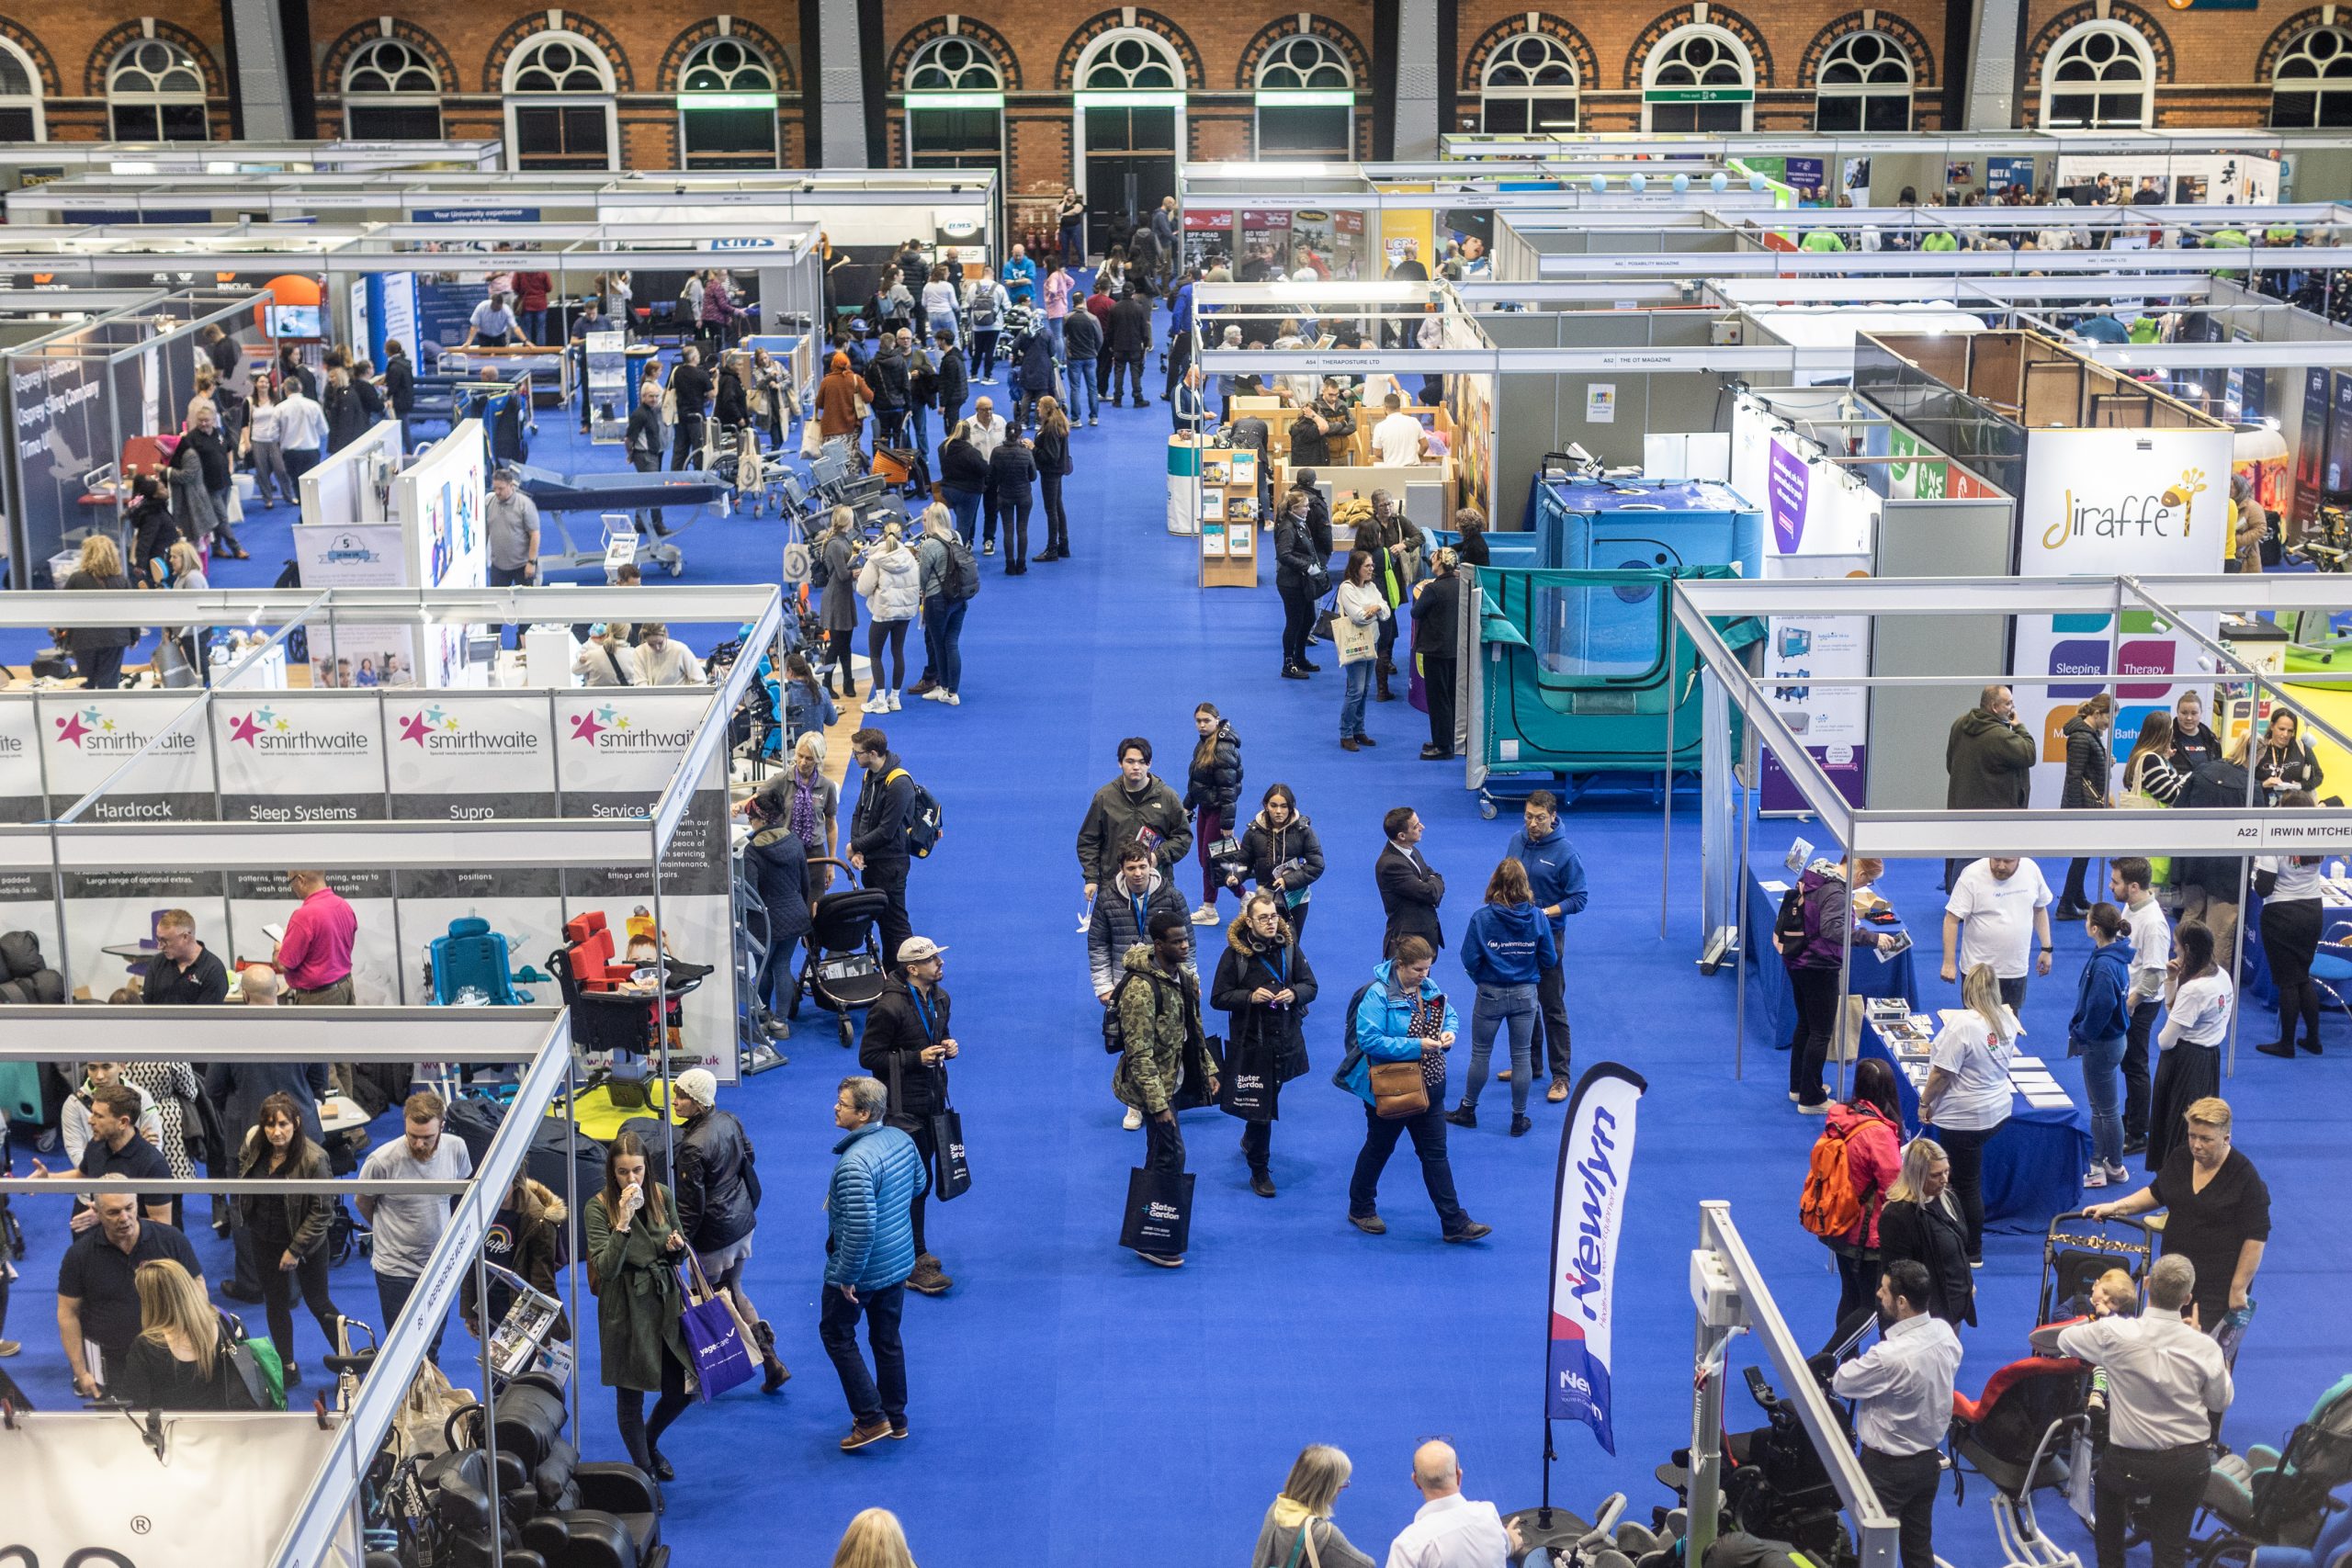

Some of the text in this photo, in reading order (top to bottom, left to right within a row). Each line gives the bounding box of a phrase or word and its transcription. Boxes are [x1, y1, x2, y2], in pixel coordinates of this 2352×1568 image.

[2056, 663, 2165, 676] Sleeping Therapy
[259, 730, 368, 750] smirthwaite
[429, 729, 537, 749] smirthwaite
[600, 728, 694, 748] smirthwai
[95, 802, 173, 818] Hardrock
[249, 805, 357, 821] Sleep Systems
[449, 805, 494, 820] Supro
[592, 804, 644, 818] Service
[2237, 827, 2352, 837] A22 IRWIN MITCHE
[673, 850, 706, 859] servicing
[660, 861, 710, 869] maintenance,
[86, 877, 107, 886] Large
[139, 876, 169, 885] optional
[170, 875, 194, 884] extras.
[238, 874, 270, 883] patterns,
[351, 874, 368, 883] easy
[458, 873, 494, 882] positions.
[607, 873, 632, 881] fittings
[334, 885, 362, 893] respite.
[1237, 1081, 1264, 1089] Gordon
[1150, 1201, 1177, 1213] Slater
[1569, 1104, 1617, 1322] Newlyn
[1148, 1210, 1180, 1220] Gordon
[454, 1222, 471, 1259] MOBILITY
[427, 1253, 456, 1313] INDEPENDENCE
[699, 1337, 729, 1358] yagecare
